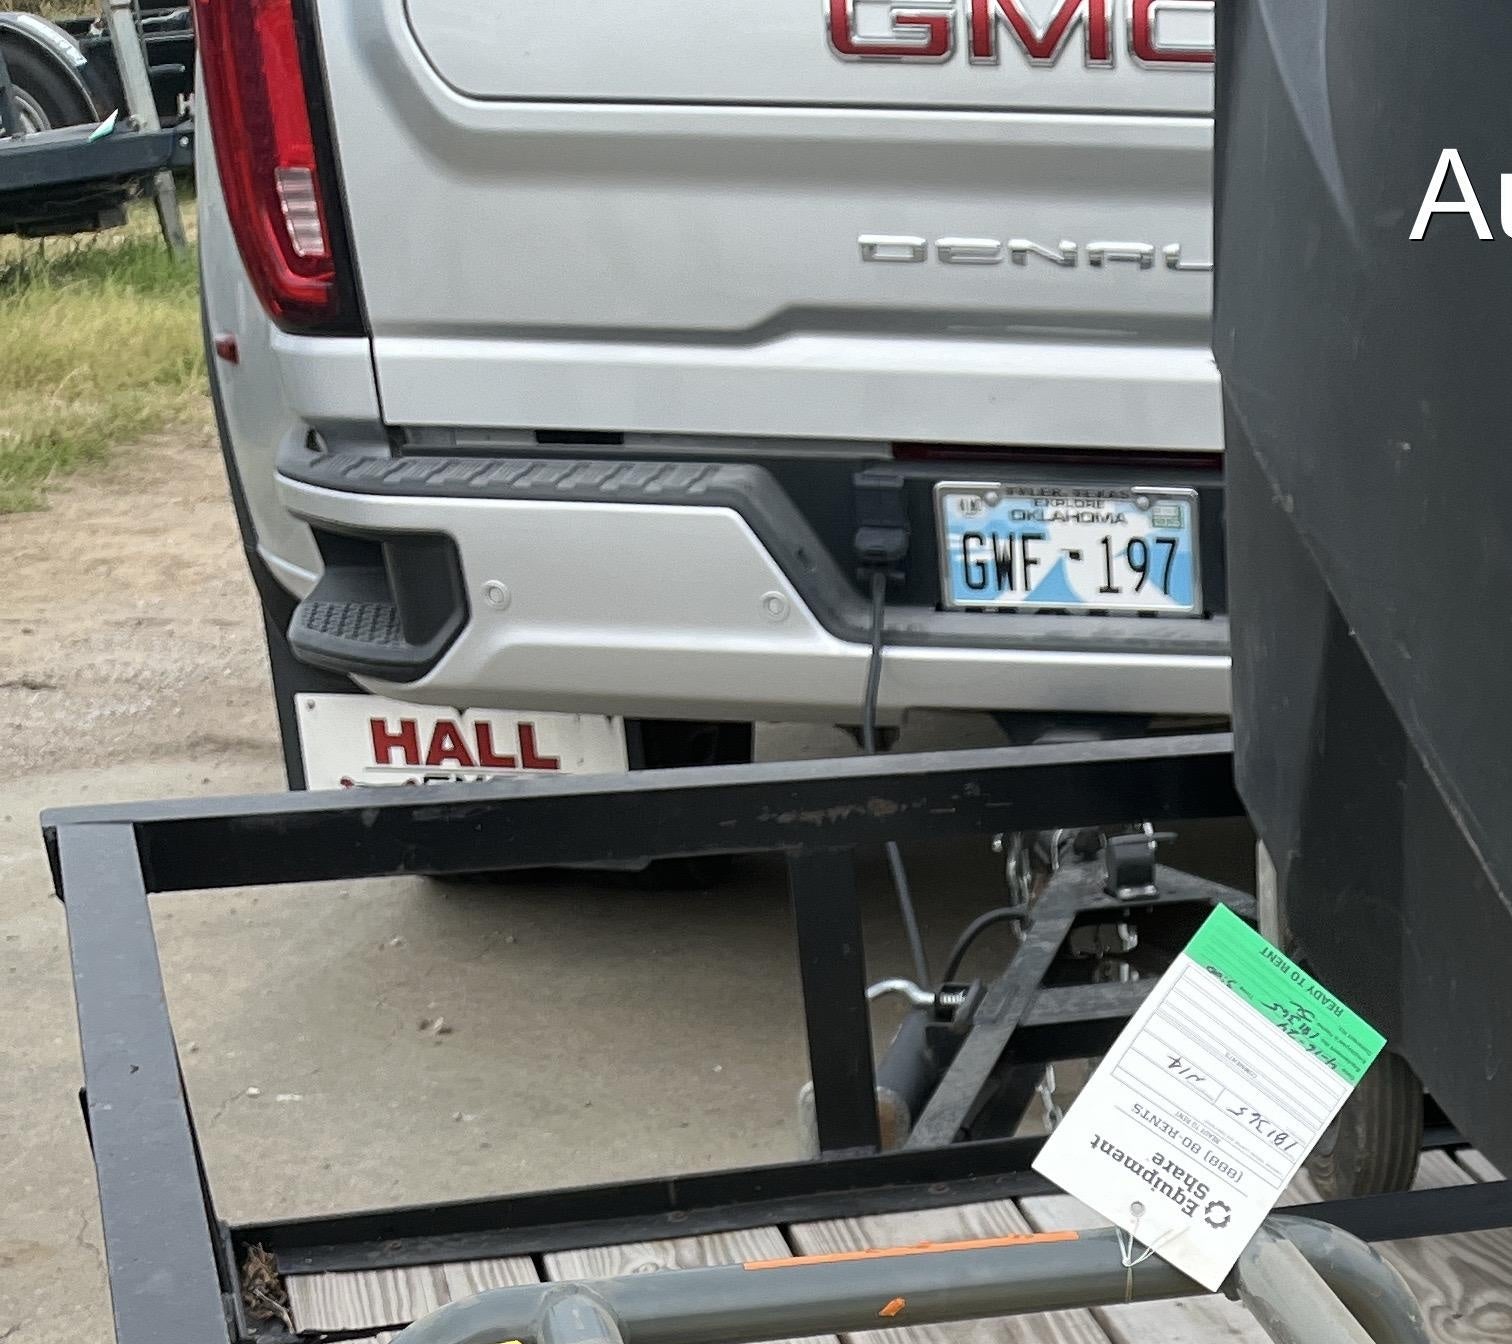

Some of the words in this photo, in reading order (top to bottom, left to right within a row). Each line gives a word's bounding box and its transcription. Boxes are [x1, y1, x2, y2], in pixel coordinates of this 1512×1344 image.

[1007, 508, 1129, 525] OKLAHOMA
[962, 530, 1048, 592] GWF
[1098, 535, 1178, 595] 197
[370, 717, 561, 770] HALL
[1258, 944, 1290, 974] RENT
[1289, 969, 1308, 988] TO
[1305, 982, 1344, 1017] READY
[1130, 1099, 1202, 1157] 80-RENTS
[1087, 1131, 1199, 1218] Equipment
[1148, 1150, 1211, 1201] Share
